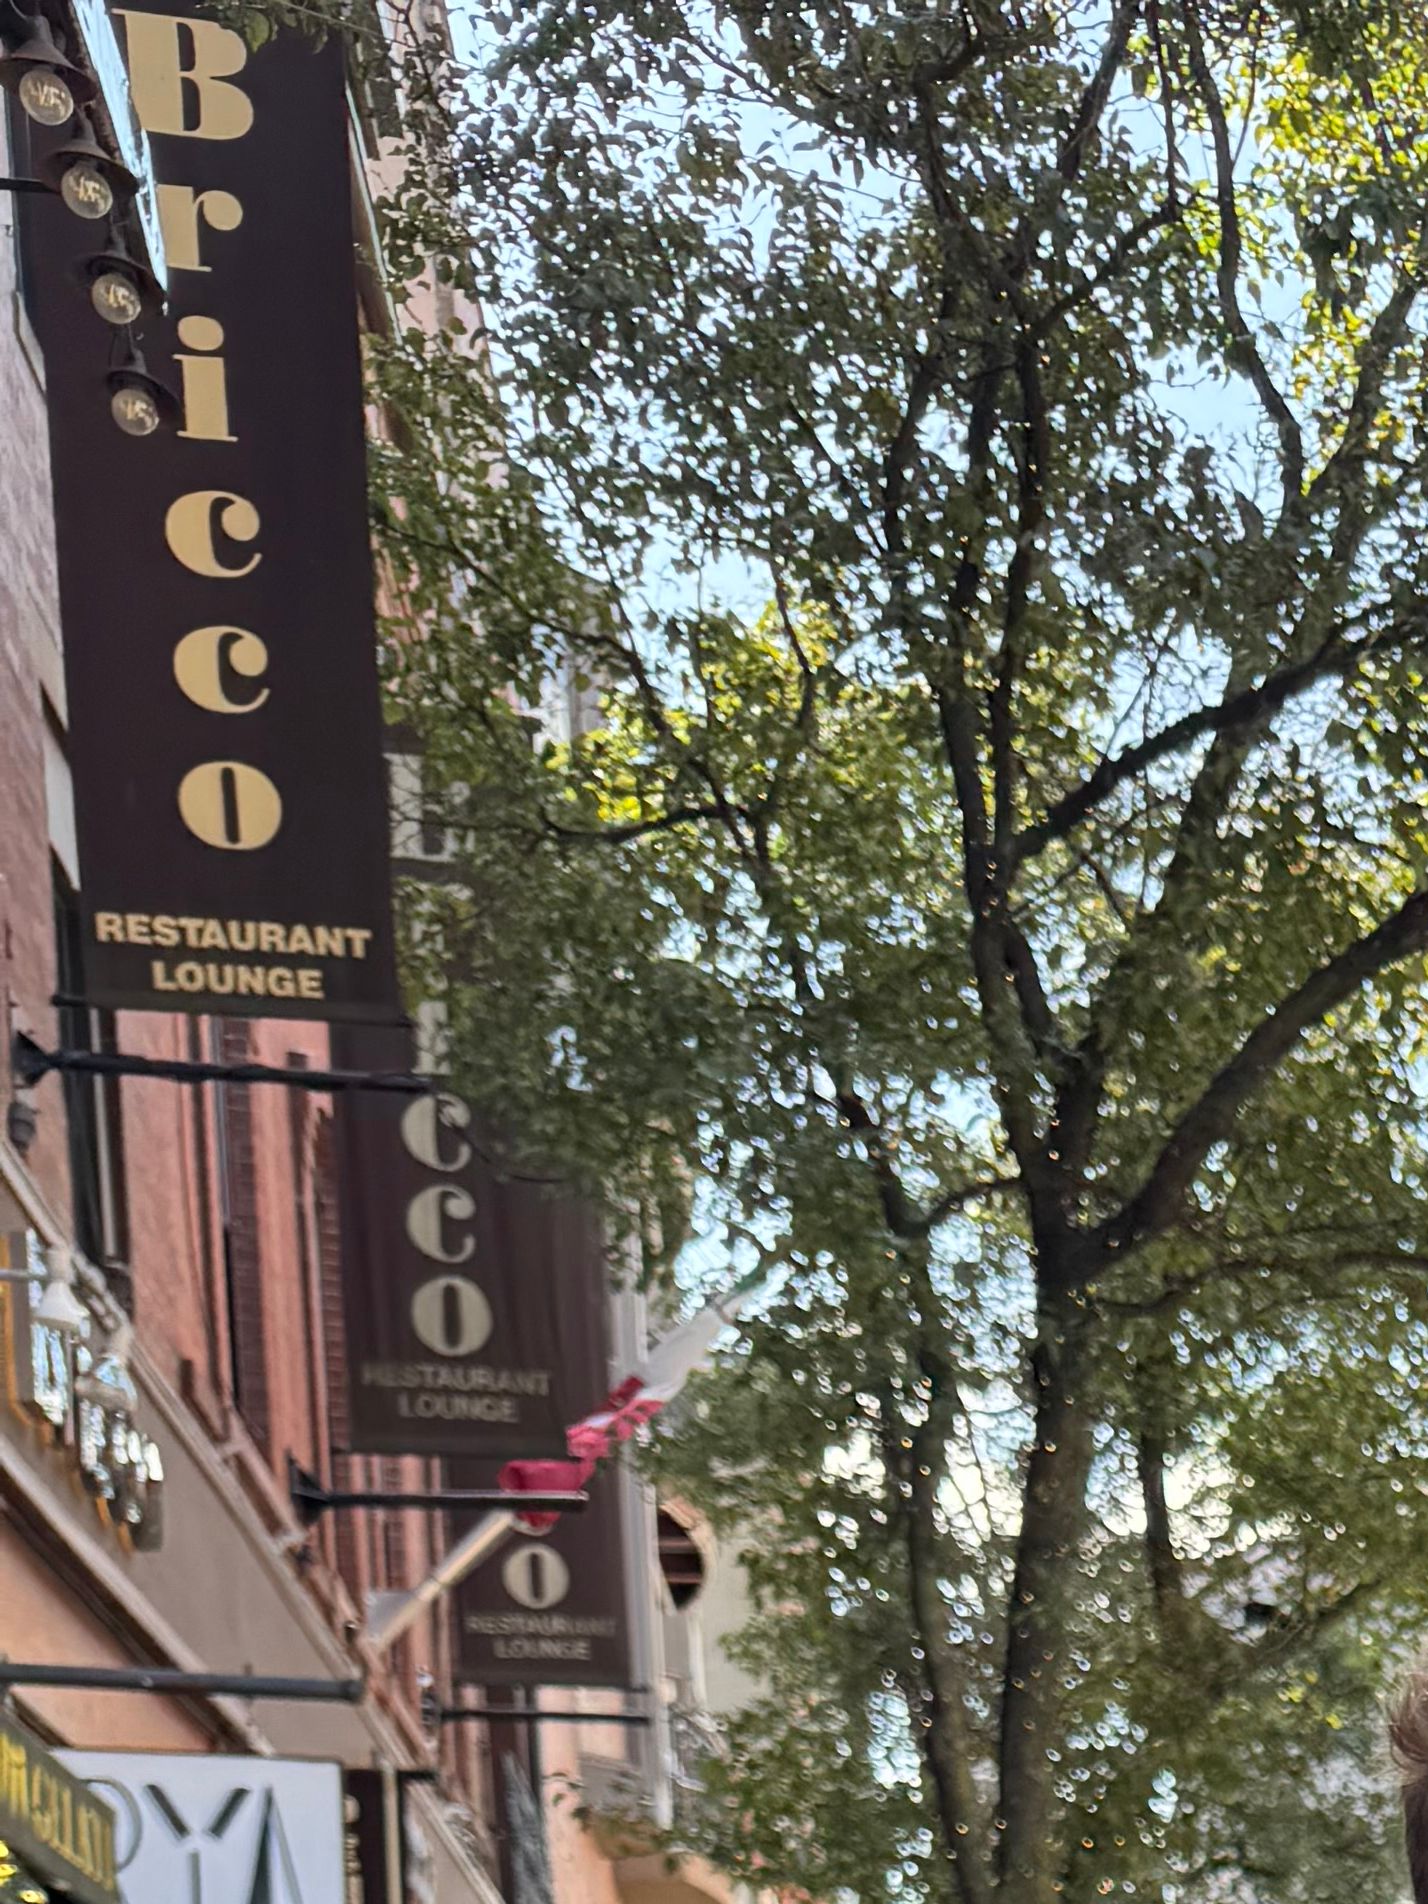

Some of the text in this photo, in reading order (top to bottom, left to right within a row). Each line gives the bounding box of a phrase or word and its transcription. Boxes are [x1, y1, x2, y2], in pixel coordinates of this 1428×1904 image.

[111, 8, 283, 850] Bricco
[95, 911, 372, 958] RESTAURANT
[152, 960, 324, 999] LOUNGE
[361, 1363, 550, 1397] RESTAURANT
[397, 1393, 519, 1424] LOUNGE
